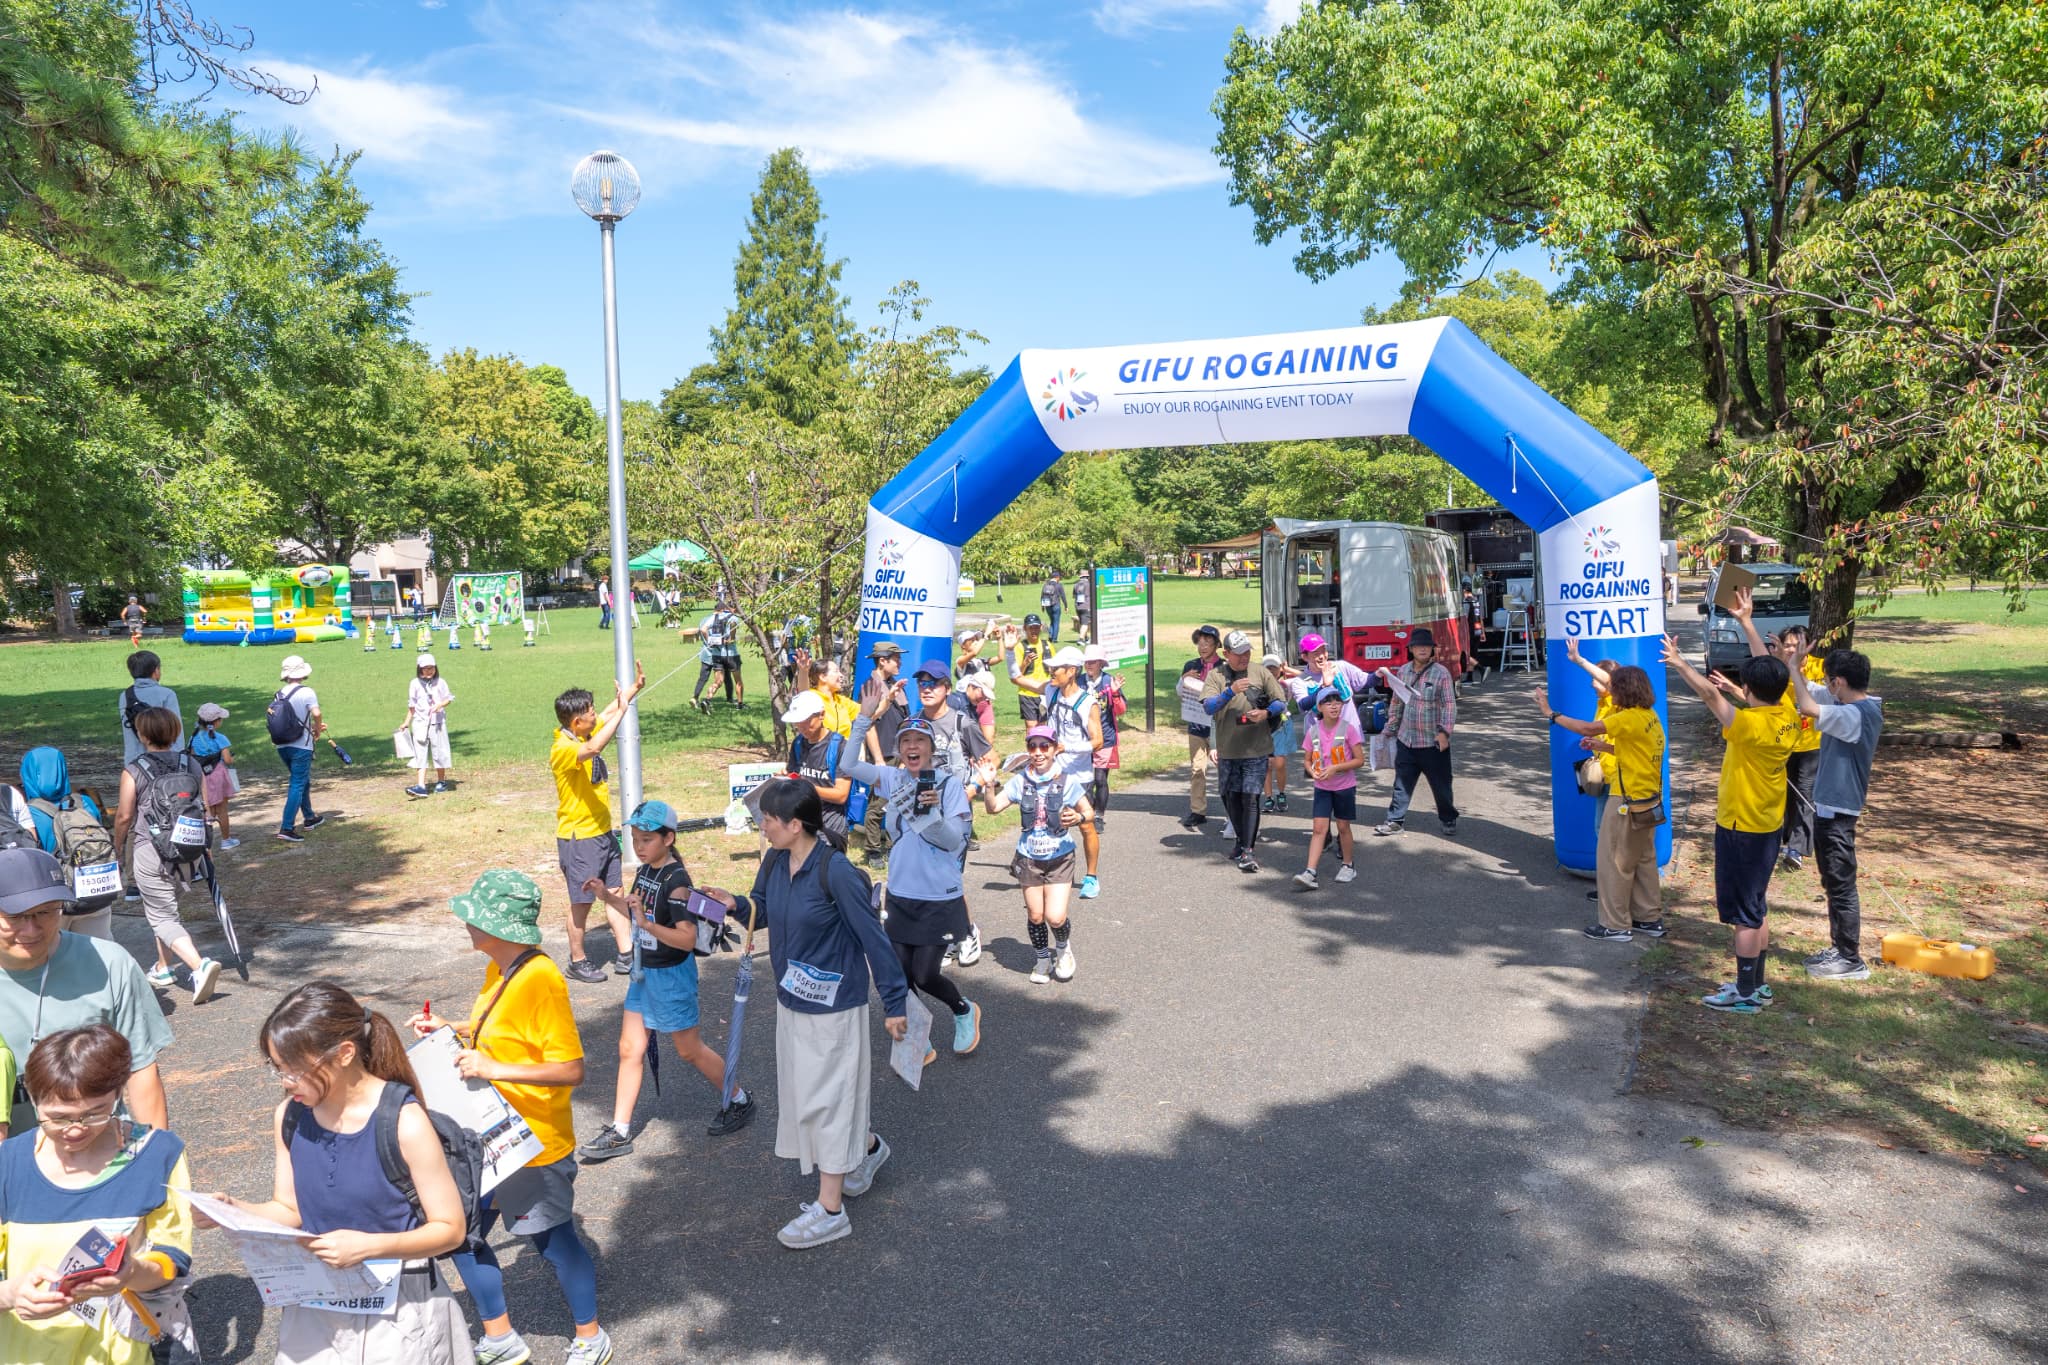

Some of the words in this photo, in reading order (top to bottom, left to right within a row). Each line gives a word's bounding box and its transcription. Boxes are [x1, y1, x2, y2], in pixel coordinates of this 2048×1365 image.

[1118, 356, 1194, 384] GIFU
[1202, 342, 1399, 381] ROGAINING
[1124, 401, 1161, 415] ENJOY
[1164, 400, 1191, 414] OUR
[1194, 397, 1263, 412] ROGAINING
[1267, 395, 1305, 409] EVENT
[1309, 392, 1353, 407] TODAY
[875, 568, 905, 584] GIFU
[1583, 560, 1625, 580] GIFU
[863, 584, 928, 602] ROGAINING
[1559, 578, 1650, 600] ROGAINING
[861, 607, 924, 633] START
[1565, 606, 1649, 637] START
